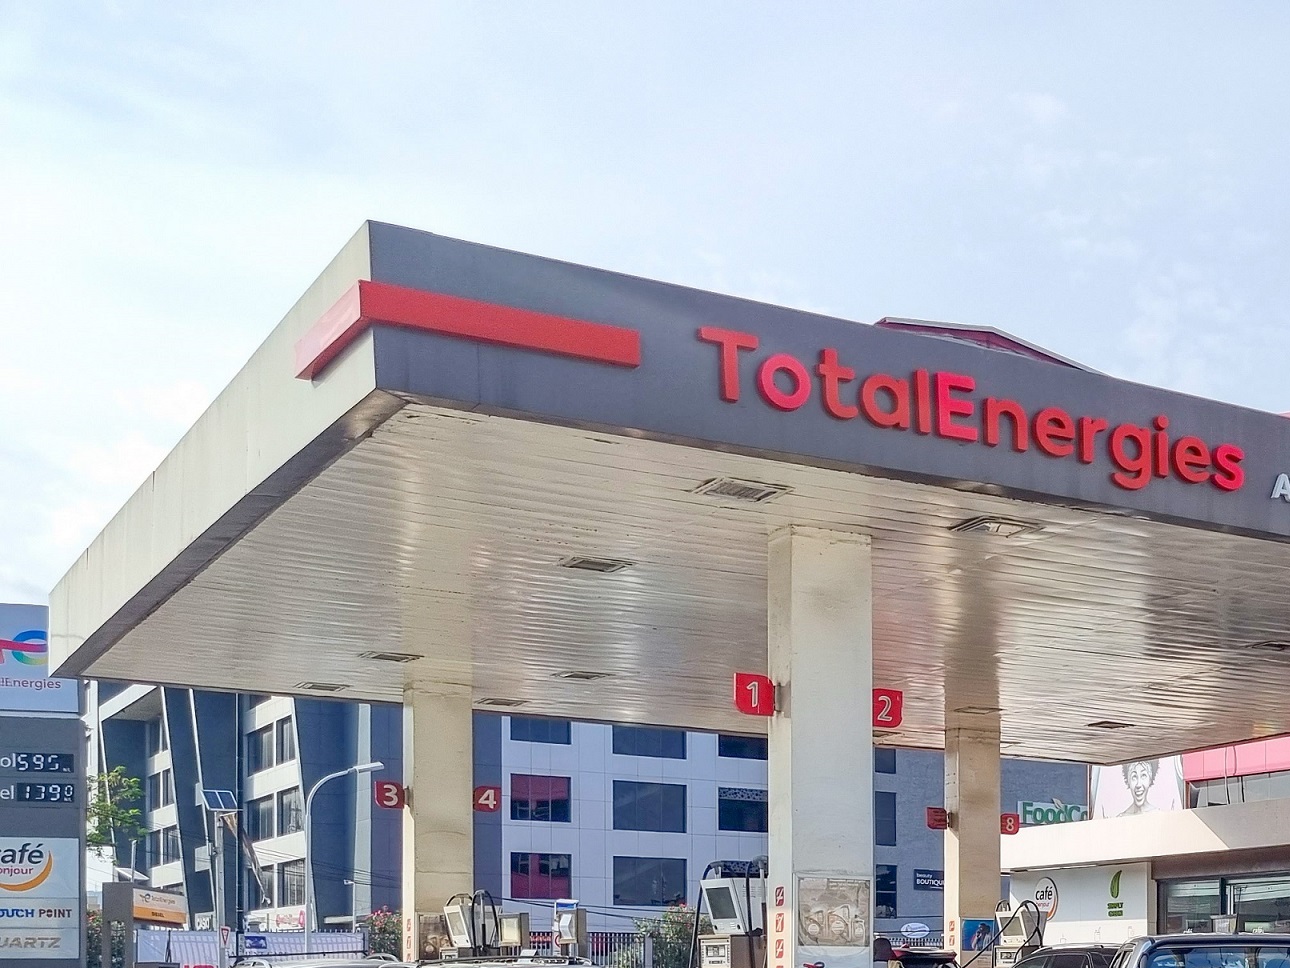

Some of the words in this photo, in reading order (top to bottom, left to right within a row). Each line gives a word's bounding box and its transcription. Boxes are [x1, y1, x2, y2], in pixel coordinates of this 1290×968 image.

[700, 325, 1246, 492] TotalEnergies
[0, 677, 62, 691] lEnergies
[746, 681, 759, 708] 1
[877, 695, 893, 722] 2
[383, 784, 399, 806] 3
[478, 789, 497, 809] 4
[1006, 817, 1015, 832] 8
[0, 843, 44, 865] afé
[1035, 886, 1053, 901] café
[38, 908, 72, 918] POINT
